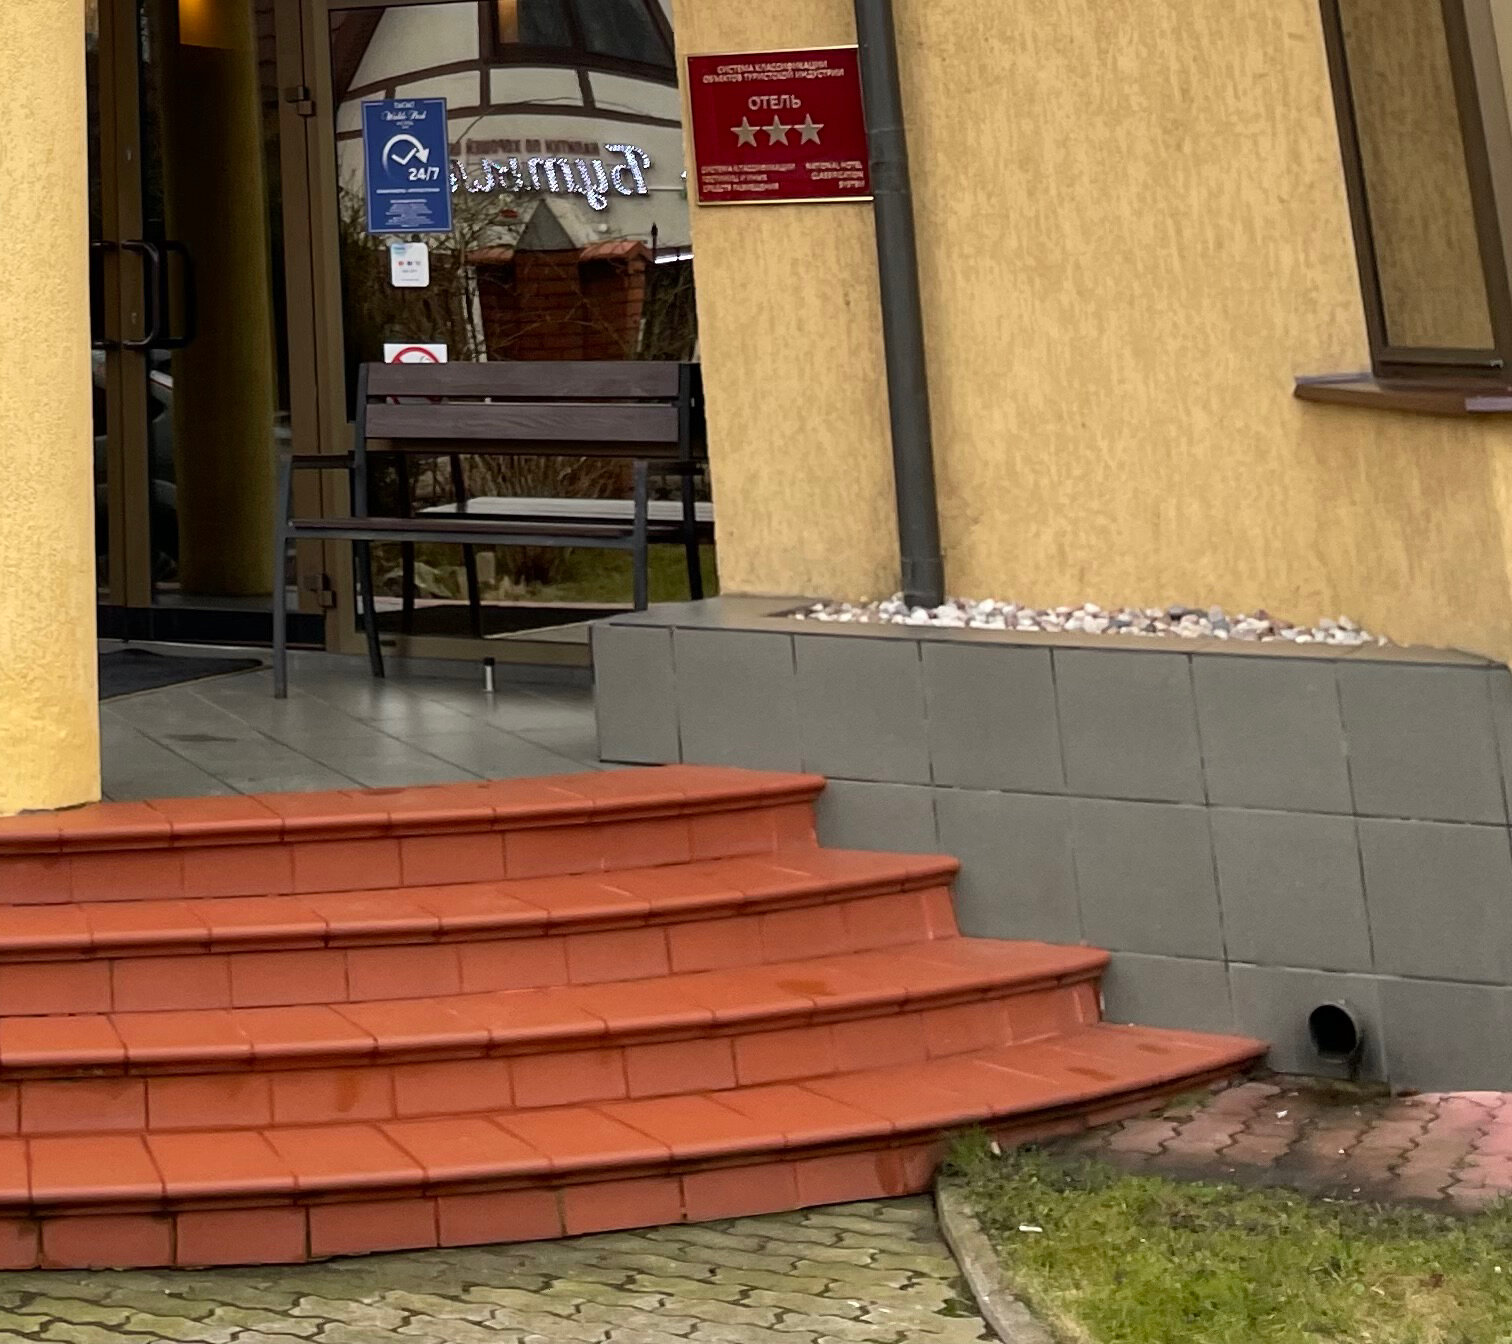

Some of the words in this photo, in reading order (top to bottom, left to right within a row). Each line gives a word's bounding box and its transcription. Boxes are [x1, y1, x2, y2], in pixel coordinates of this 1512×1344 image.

[717, 64, 754, 74] СИСТЕМА
[747, 94, 802, 110] ОТЕЛЬ
[408, 166, 440, 181] 24/7
